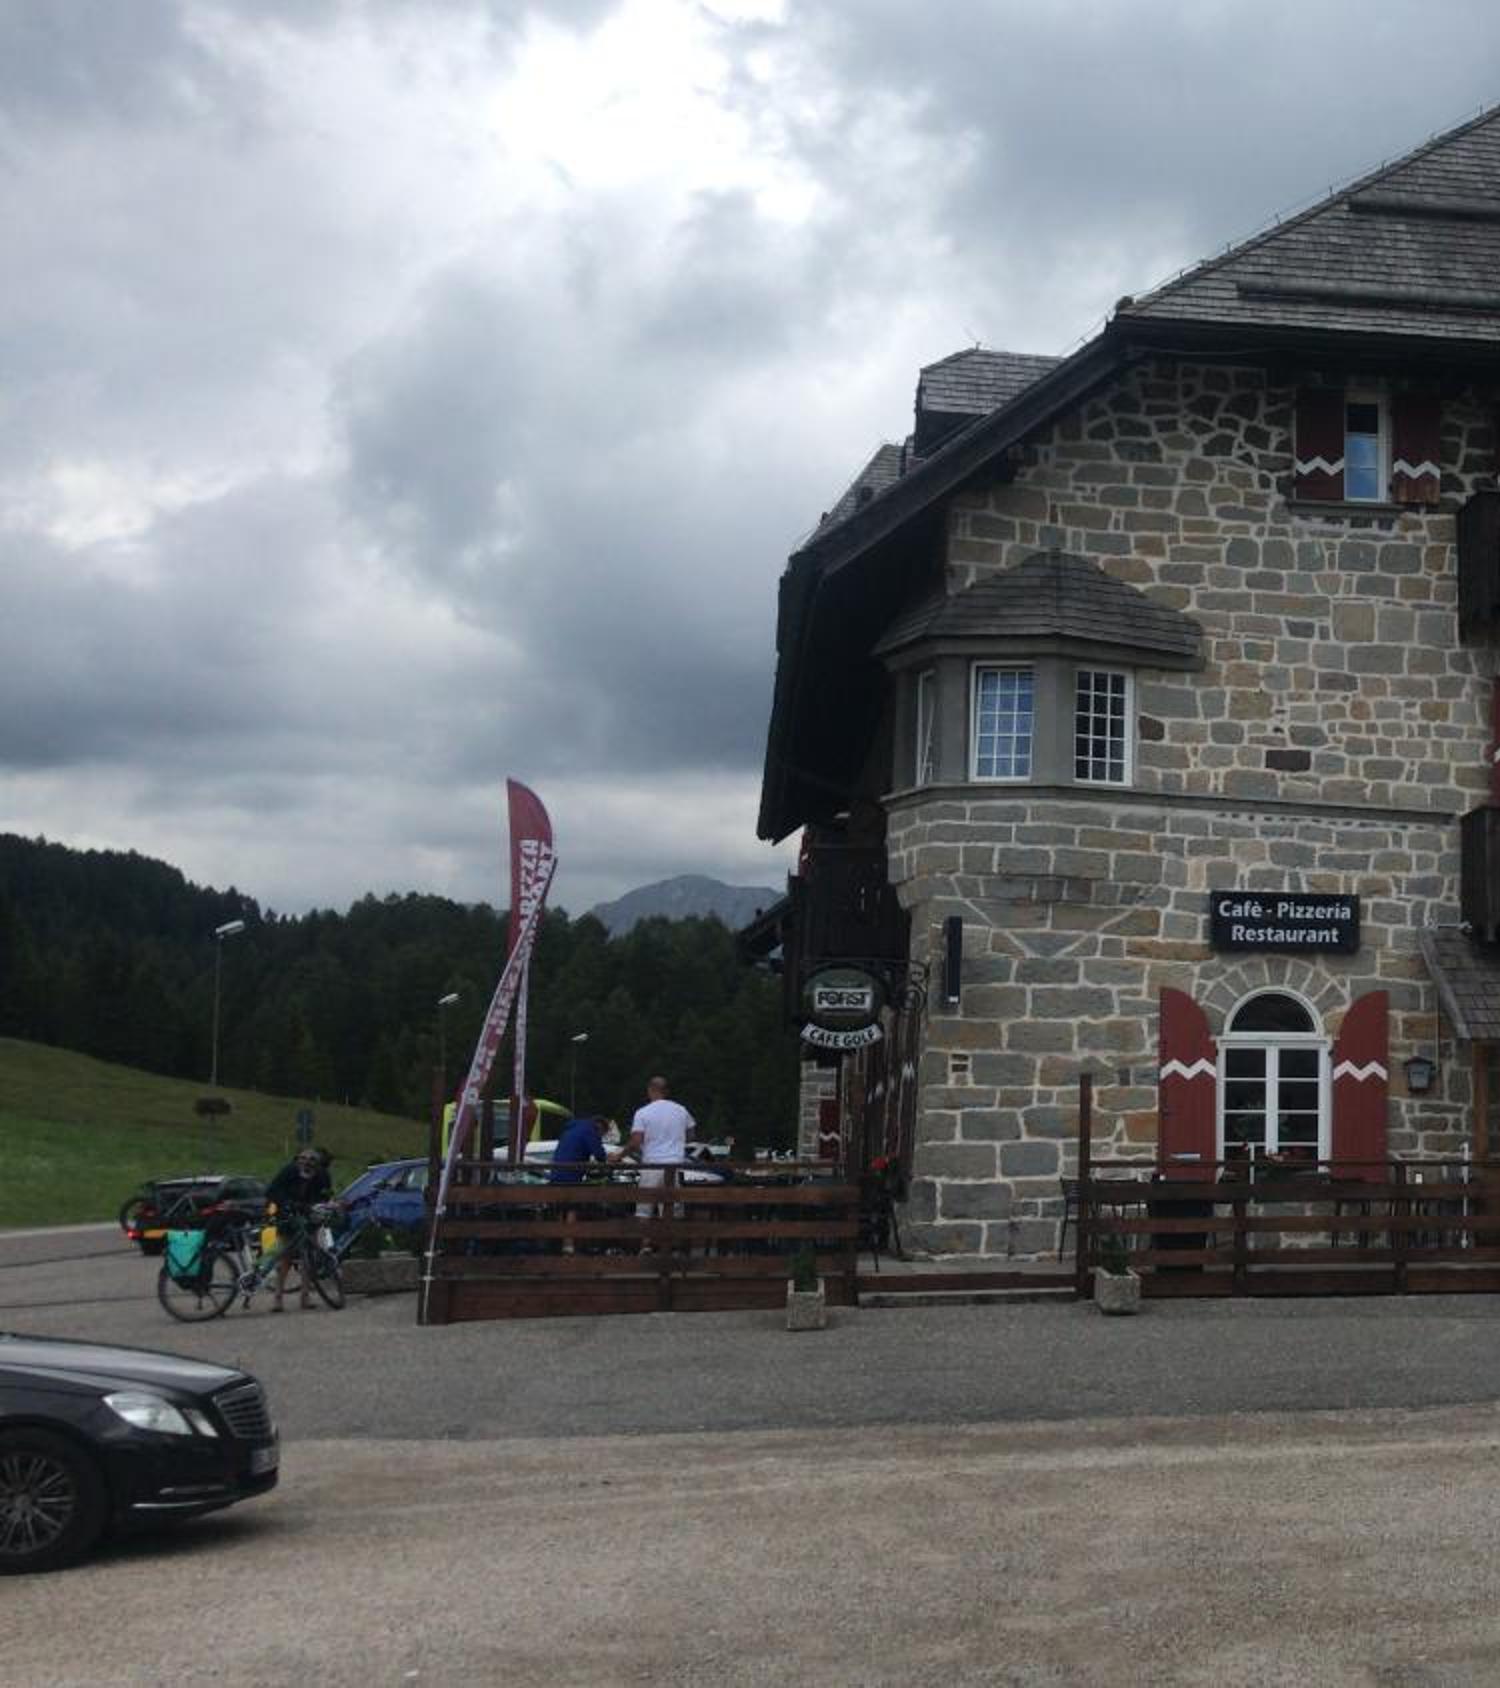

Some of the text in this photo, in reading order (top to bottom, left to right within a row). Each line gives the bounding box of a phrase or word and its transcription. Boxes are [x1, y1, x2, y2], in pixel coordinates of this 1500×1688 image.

[1277, 901, 1352, 920] Pizzeria
[1231, 925, 1339, 943] Restaurant
[817, 991, 870, 1006] FORST
[843, 1028, 876, 1046] GOLF
